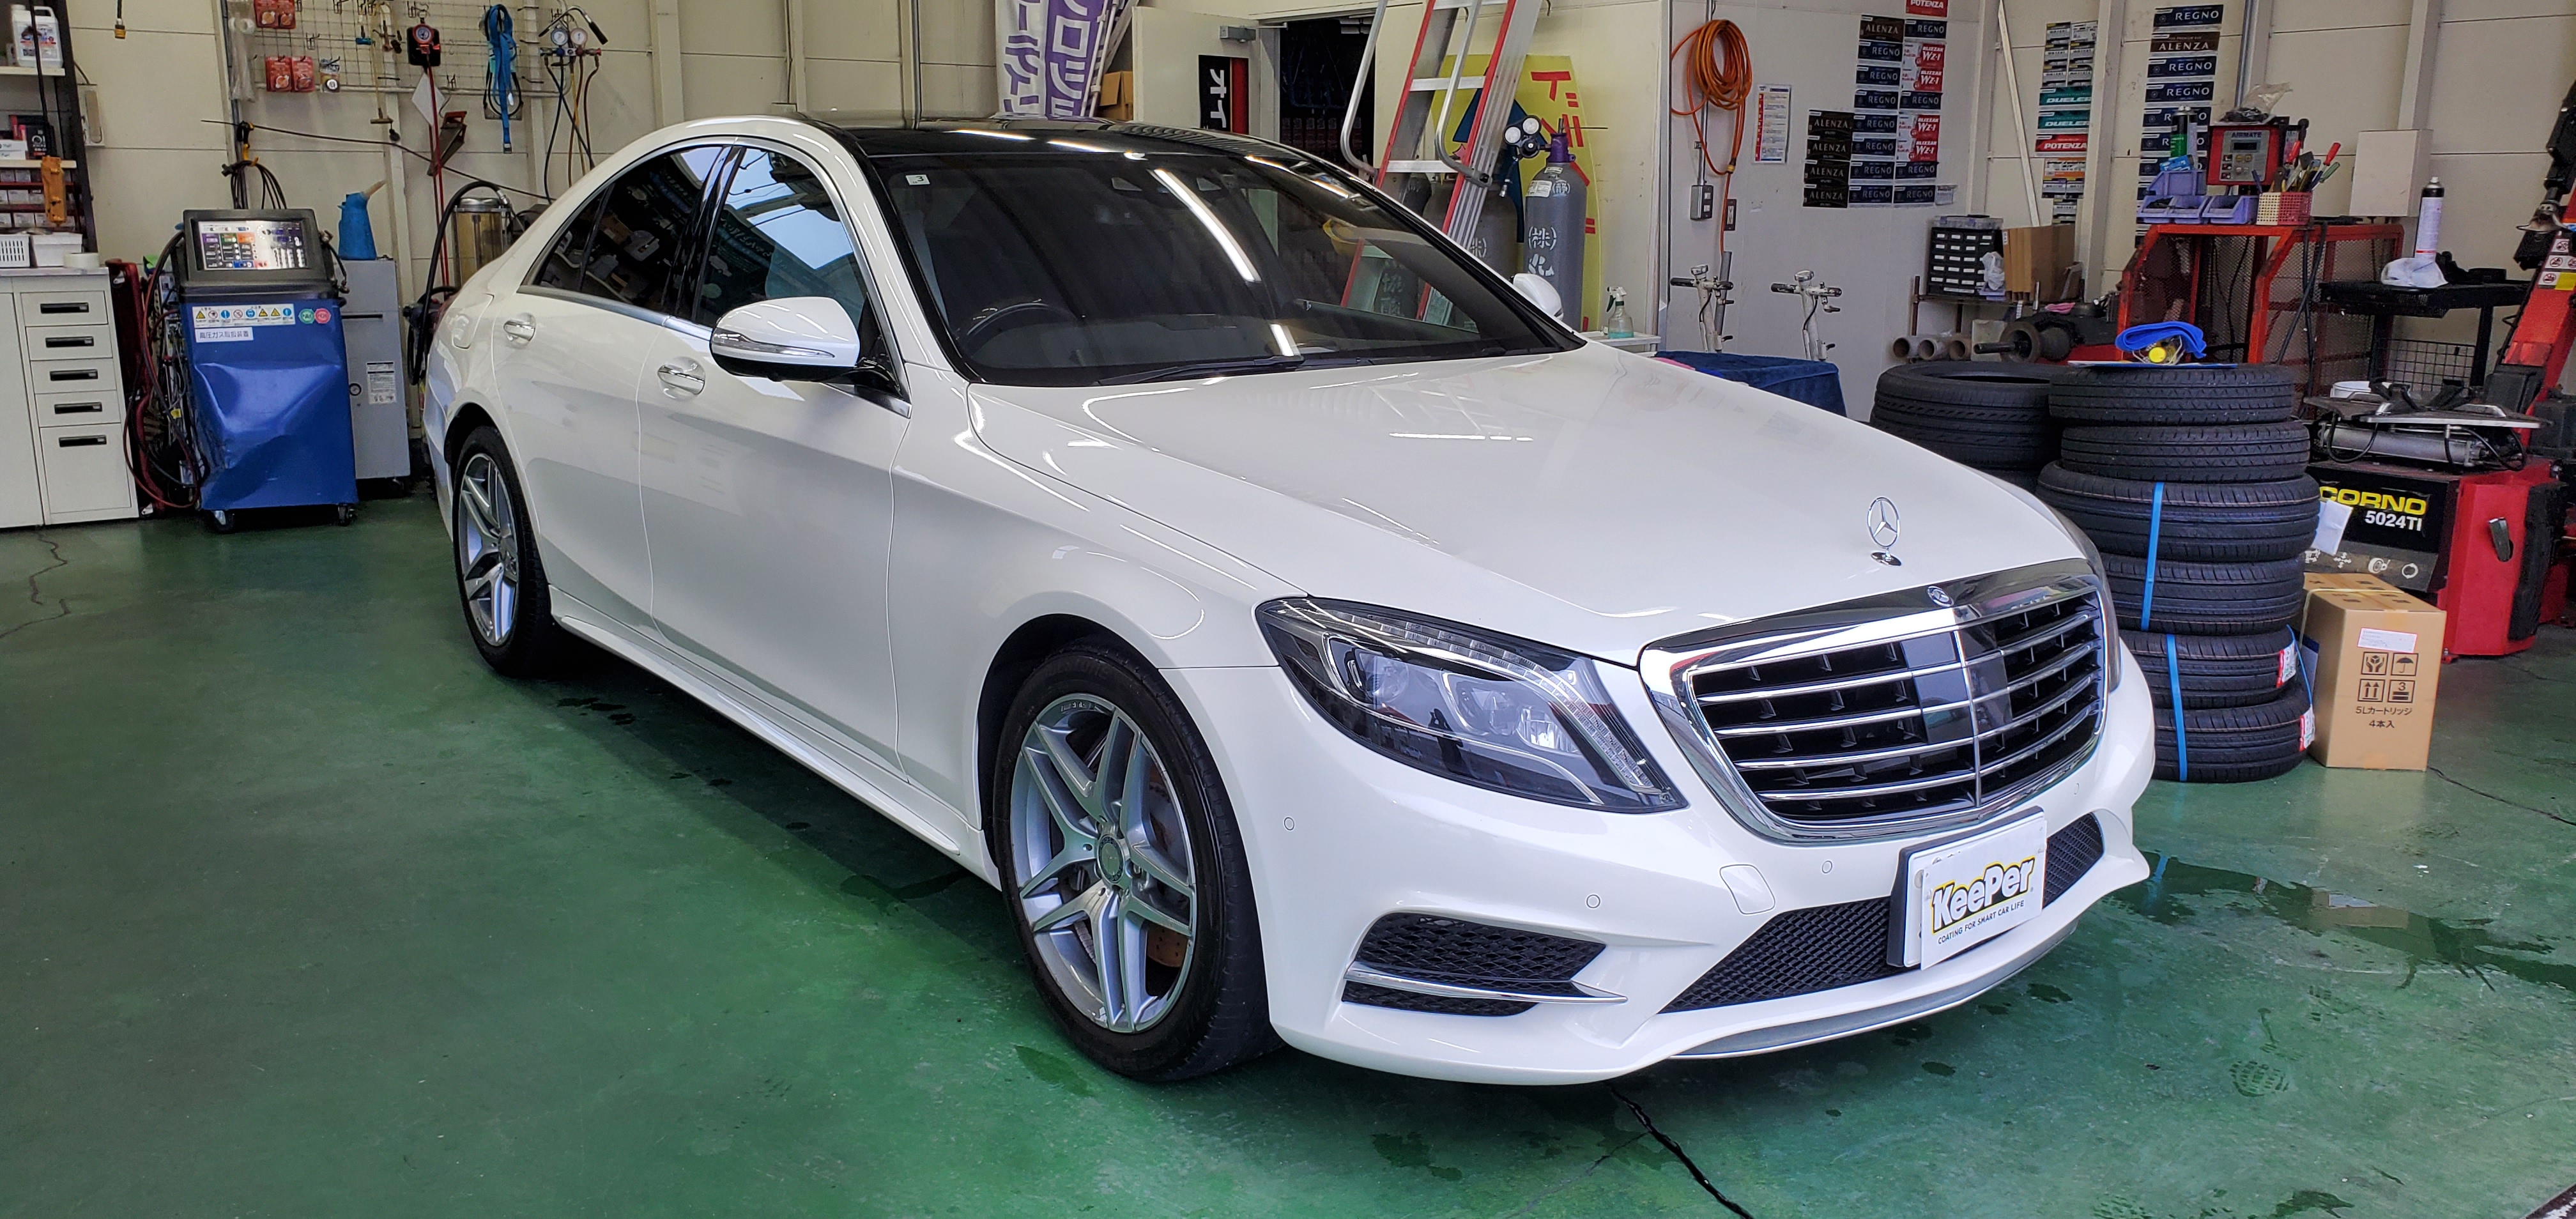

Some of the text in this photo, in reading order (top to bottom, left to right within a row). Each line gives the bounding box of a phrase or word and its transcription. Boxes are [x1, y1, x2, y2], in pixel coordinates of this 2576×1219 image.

[2175, 10, 2219, 20] REGNO
[1866, 24, 1898, 34] ALENZA
[1917, 24, 1944, 33] REGNO
[2159, 42, 2209, 50] ALENZA
[1872, 47, 1900, 56] REGNO
[2169, 62, 2212, 72] REGNO
[1870, 72, 1898, 80] REGNO
[2166, 87, 2210, 96] REGNO
[1868, 96, 1896, 105] REGNO
[1912, 96, 1939, 105] REGNO
[1814, 119, 1848, 129] ALENZA
[1867, 119, 1895, 128] REGNO
[1812, 142, 1846, 153] ALENZA
[1866, 142, 1894, 151] REGNO
[1810, 167, 1844, 177] ALENZA
[1864, 165, 1892, 174] REGNO
[1908, 165, 1935, 174] REGNO
[1809, 190, 1843, 200] ALENZA
[1862, 189, 1890, 199] REGNO
[1906, 189, 1933, 199] REGNO
[2365, 510, 2423, 532] 5024TI
[2356, 706, 2412, 716] 5Lカートリッジ
[2368, 720, 2395, 729] 4本入
[1931, 856, 2035, 935] KeePer
[1938, 900, 2025, 944] COATING FOR SMART CAR LIFE
